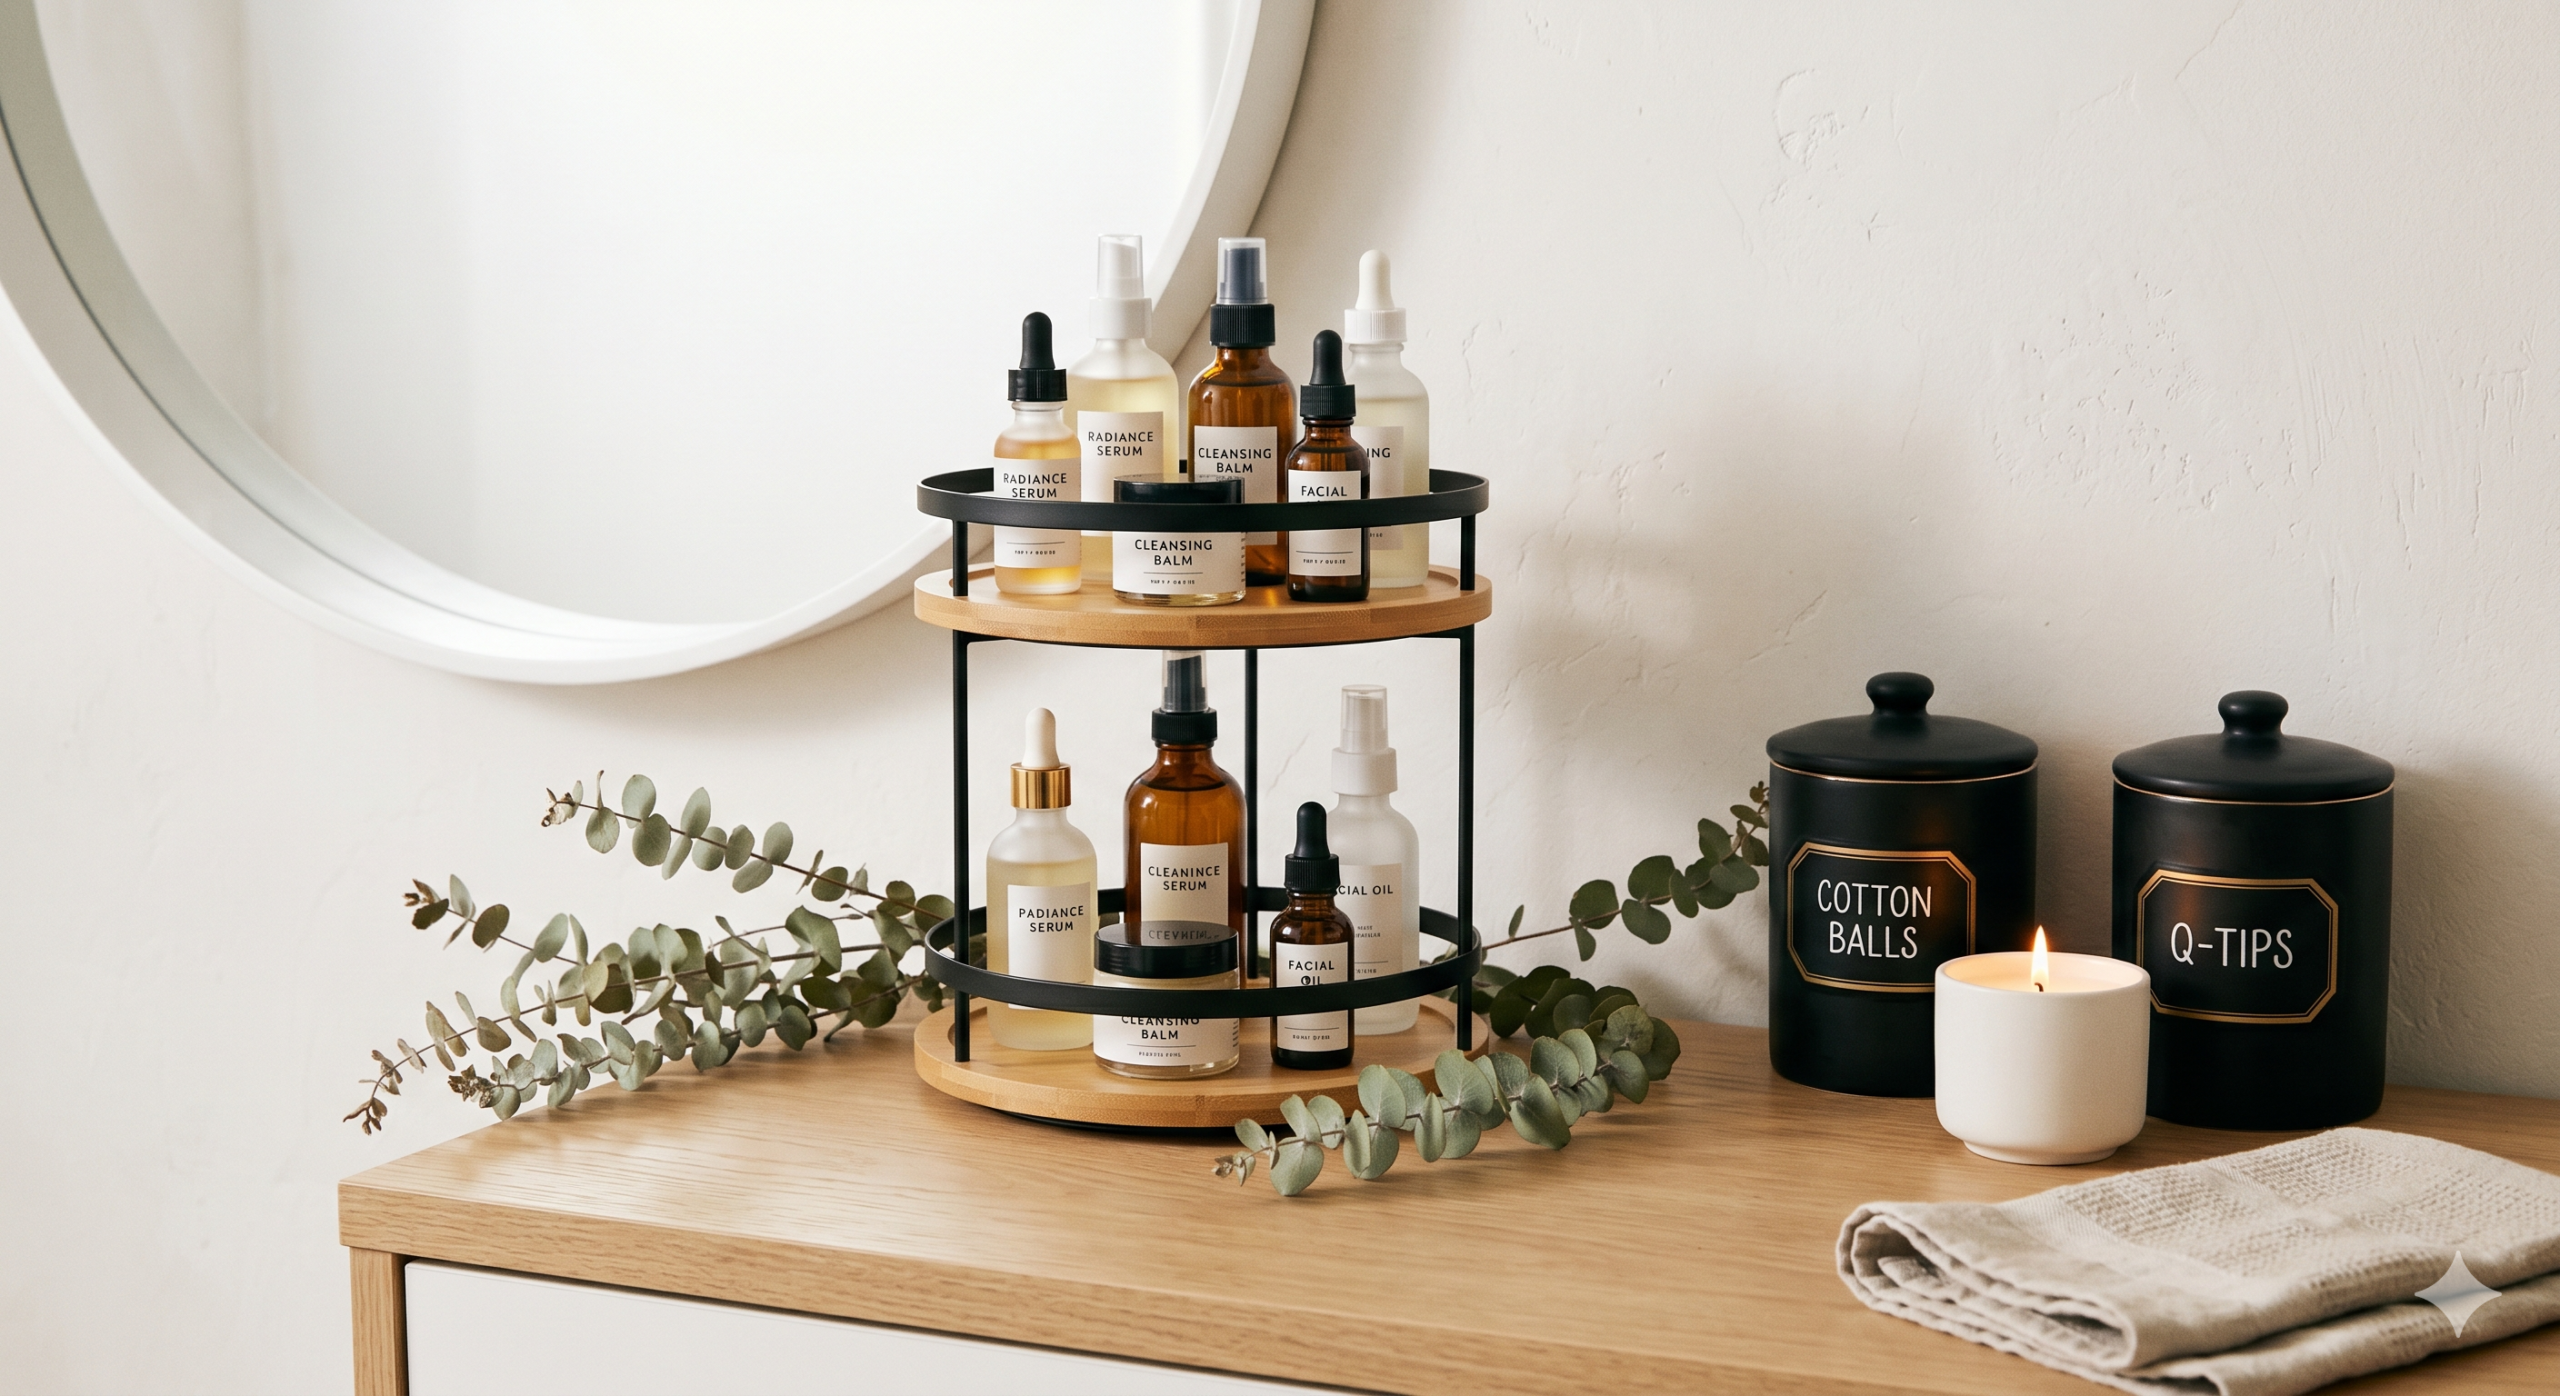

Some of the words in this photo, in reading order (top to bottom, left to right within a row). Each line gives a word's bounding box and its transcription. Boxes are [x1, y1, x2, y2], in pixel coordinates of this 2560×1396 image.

[1088, 431, 1154, 443] RADIANCE
[1097, 445, 1143, 457] SERUM
[1198, 447, 1272, 460] CLEANSING
[1216, 462, 1253, 474] BALM
[1003, 472, 1068, 485] RADIANCE
[1011, 487, 1058, 499] SERUM
[1301, 485, 1348, 497] FACIAL
[1134, 539, 1213, 552] CLEANSING
[1154, 554, 1193, 566] BALM
[1148, 865, 1220, 878] CLEANINCE
[1163, 880, 1207, 891] SERUM
[1338, 884, 1368, 896] CIAL
[1372, 884, 1394, 896] OIL
[1817, 879, 1932, 918] COTTON
[1019, 905, 1085, 919] PADIANCE
[1029, 920, 1074, 933] SERUM
[1829, 920, 1918, 960] BALLS
[2170, 921, 2294, 970] Q-TIPS
[1288, 960, 1335, 971] FACIAL
[1141, 1029, 1179, 1040] BALM
